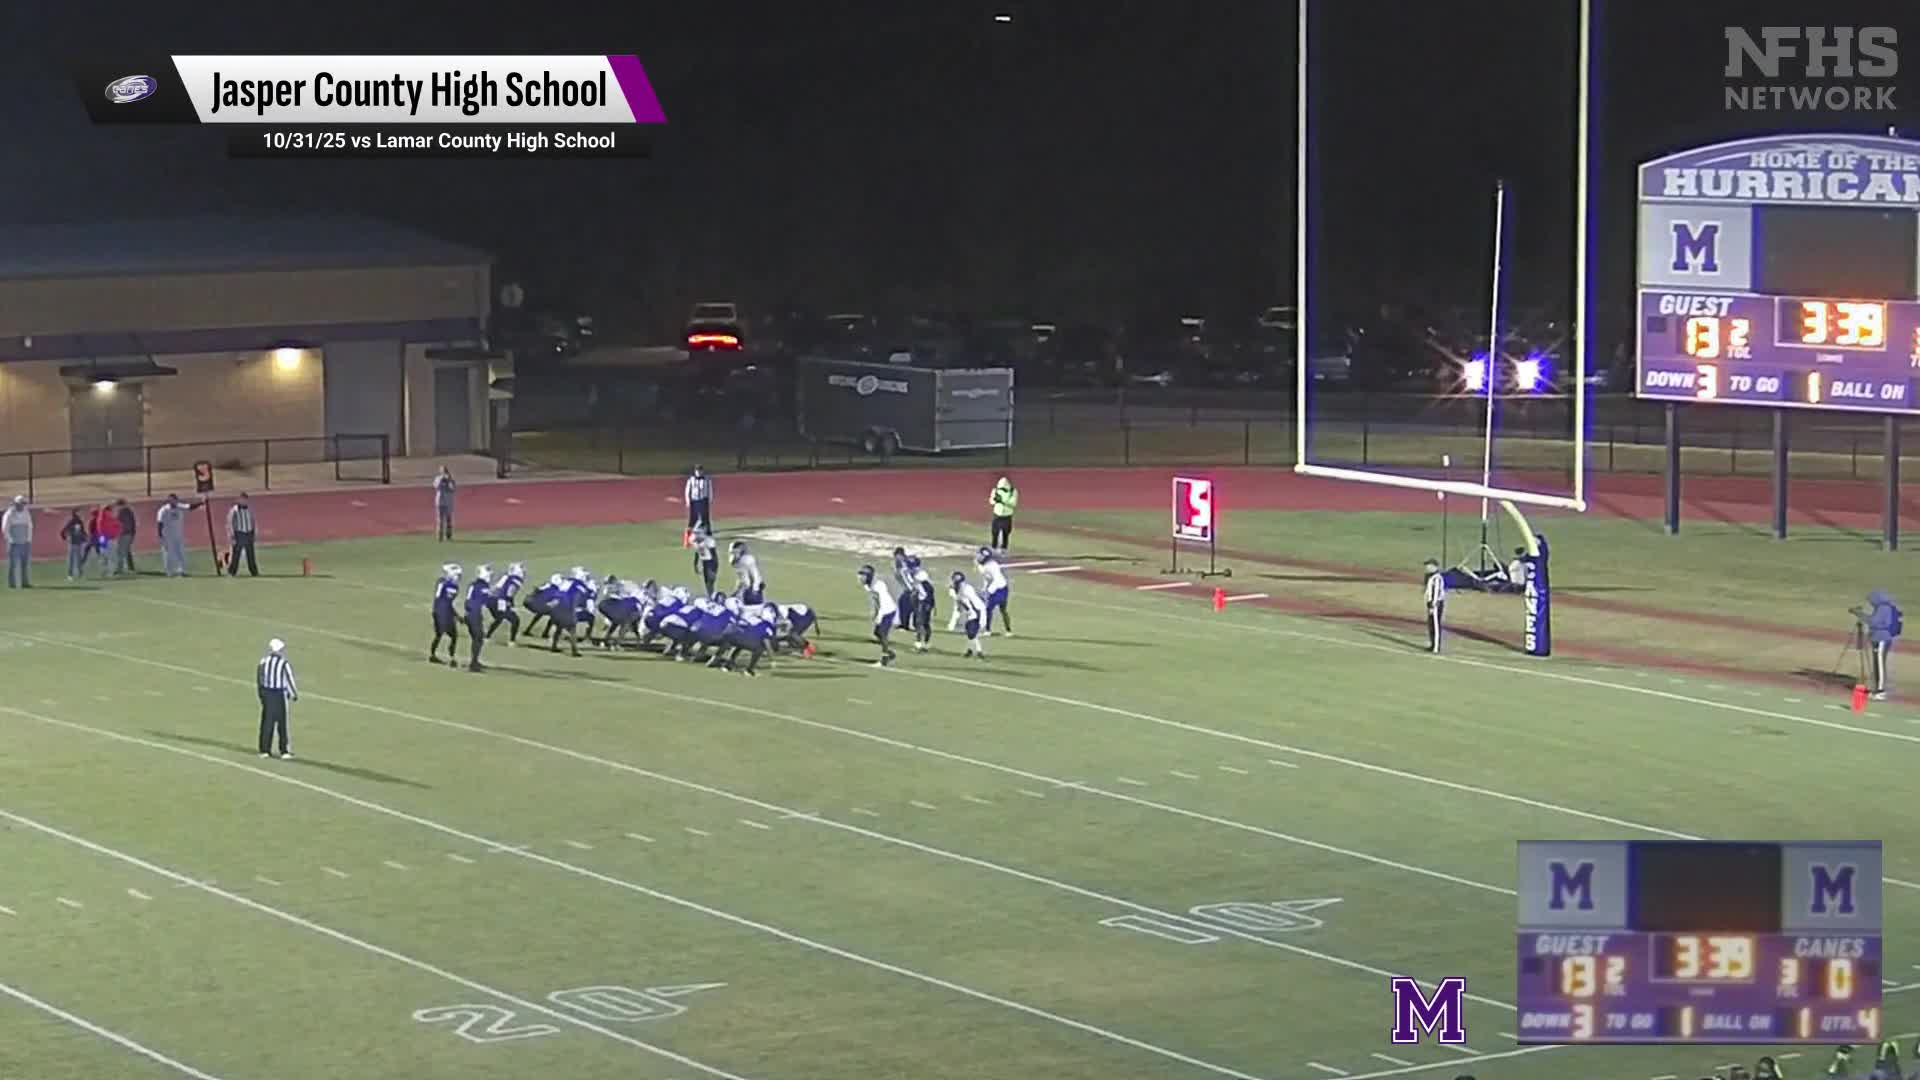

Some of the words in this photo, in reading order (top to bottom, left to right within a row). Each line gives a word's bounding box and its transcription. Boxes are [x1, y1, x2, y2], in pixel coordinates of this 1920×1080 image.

[1750, 151, 1822, 168] HOME
[1827, 152, 1858, 169] OF
[1866, 154, 1918, 170] THE
[1671, 221, 1720, 275] M
[1659, 295, 1734, 316] GUEST
[1801, 302, 1883, 346] 3:39
[1686, 317, 1719, 358] 13
[1731, 319, 1750, 346] 2
[1646, 371, 1696, 388] DOWN
[1697, 365, 1717, 399] 3
[1730, 376, 1751, 391] TO
[1755, 377, 1779, 392] GO
[1808, 372, 1820, 403] 1
[1831, 381, 1875, 399] BALL
[1880, 383, 1905, 400] ON
[1098, 902, 1325, 944] 10
[412, 985, 689, 1043] 20
